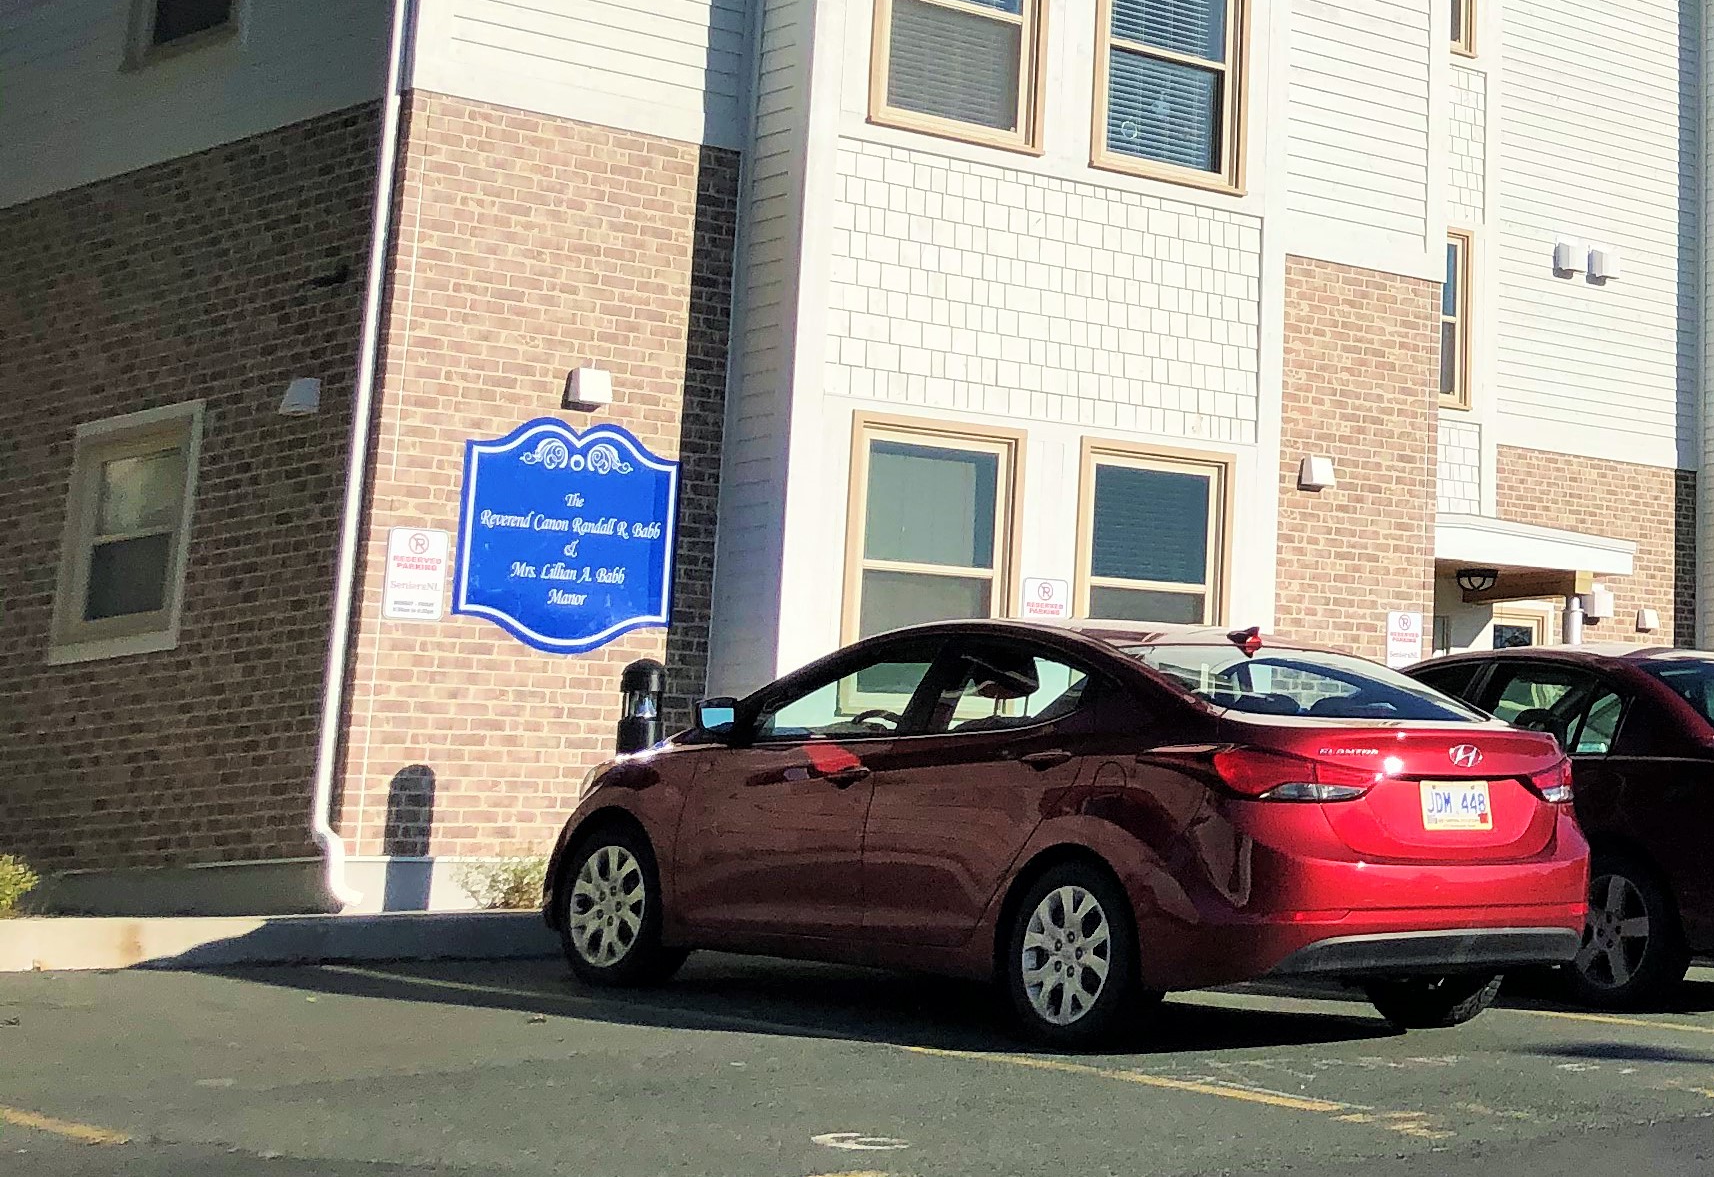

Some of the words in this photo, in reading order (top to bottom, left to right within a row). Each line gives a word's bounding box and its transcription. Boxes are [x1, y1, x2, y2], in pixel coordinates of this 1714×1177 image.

[564, 492, 585, 508] The
[480, 509, 535, 529] Reverend
[533, 513, 570, 532] Canon
[572, 517, 618, 536] Randall
[631, 521, 662, 540] Babb
[393, 555, 442, 565] RESERVED
[396, 562, 438, 572] PARKING
[540, 562, 578, 581] Lillian
[595, 566, 626, 585] Babb
[546, 588, 588, 606] Manor
[1427, 791, 1453, 814] JDM
